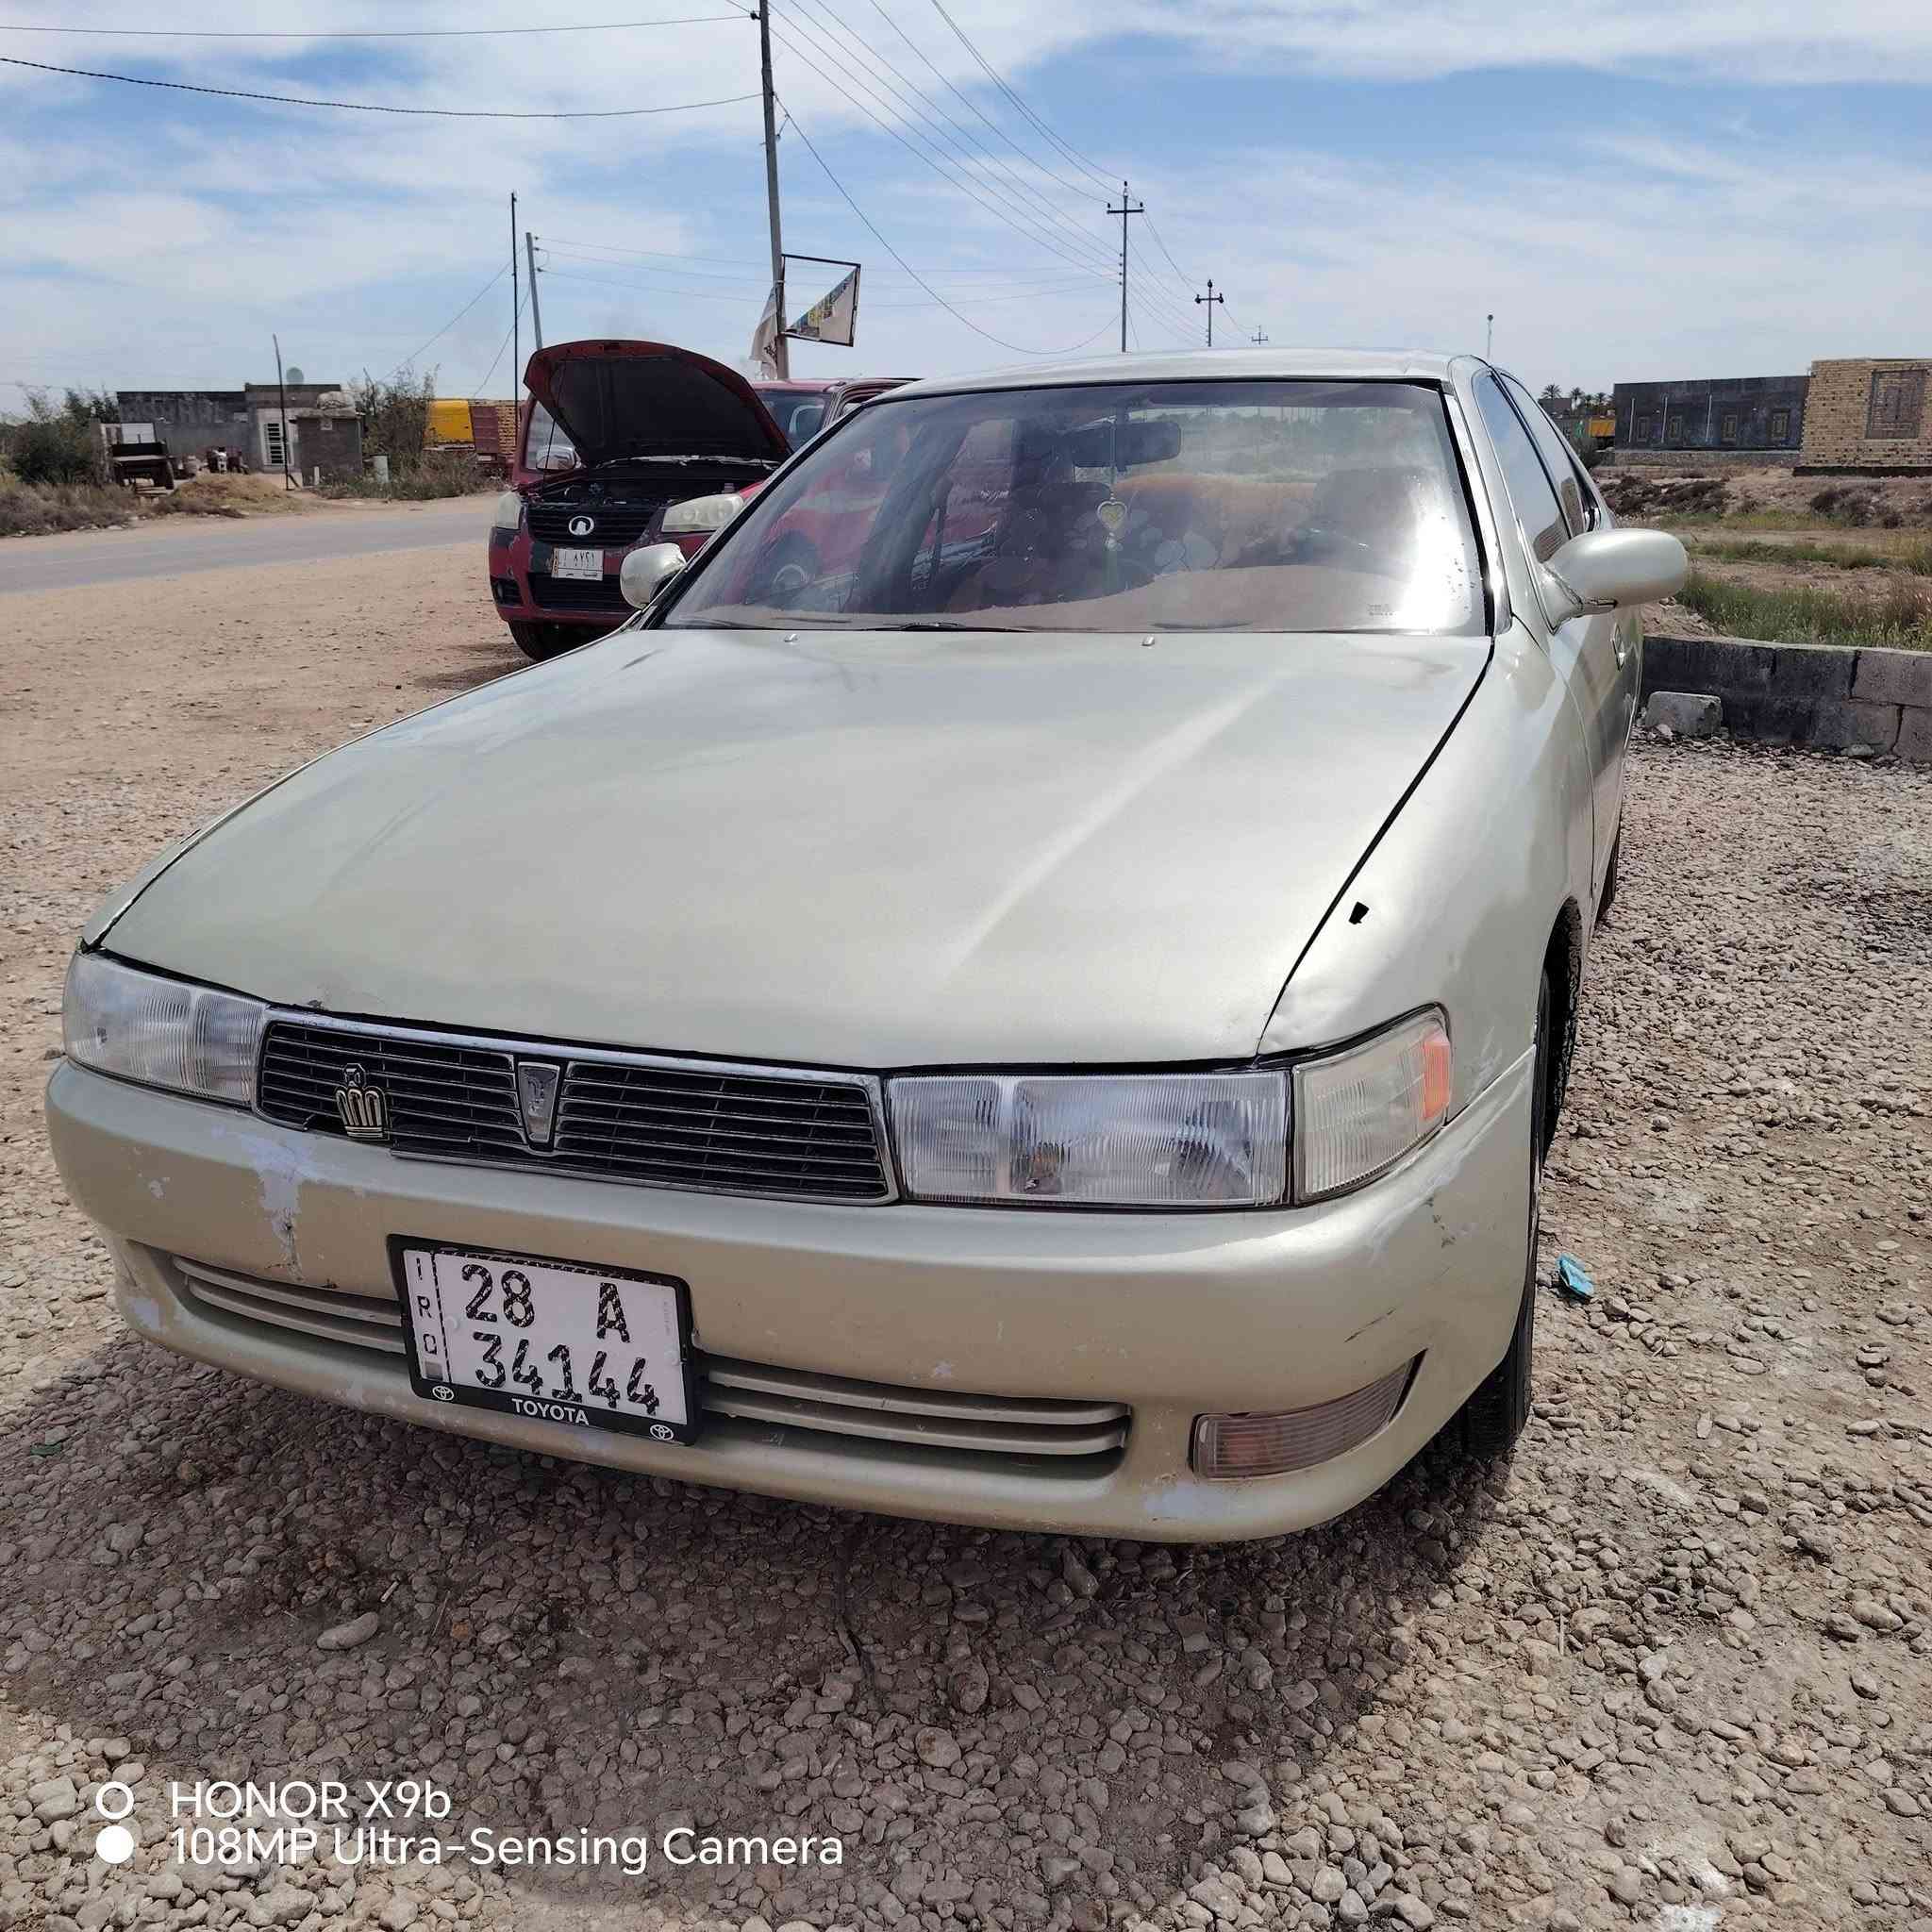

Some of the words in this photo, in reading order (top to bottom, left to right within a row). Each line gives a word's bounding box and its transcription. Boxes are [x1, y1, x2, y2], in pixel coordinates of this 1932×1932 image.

[461, 1264, 535, 1328] 28
[596, 1282, 630, 1343] A
[473, 1331, 659, 1416] 34144
[511, 1397, 590, 1426] TOYOTA
